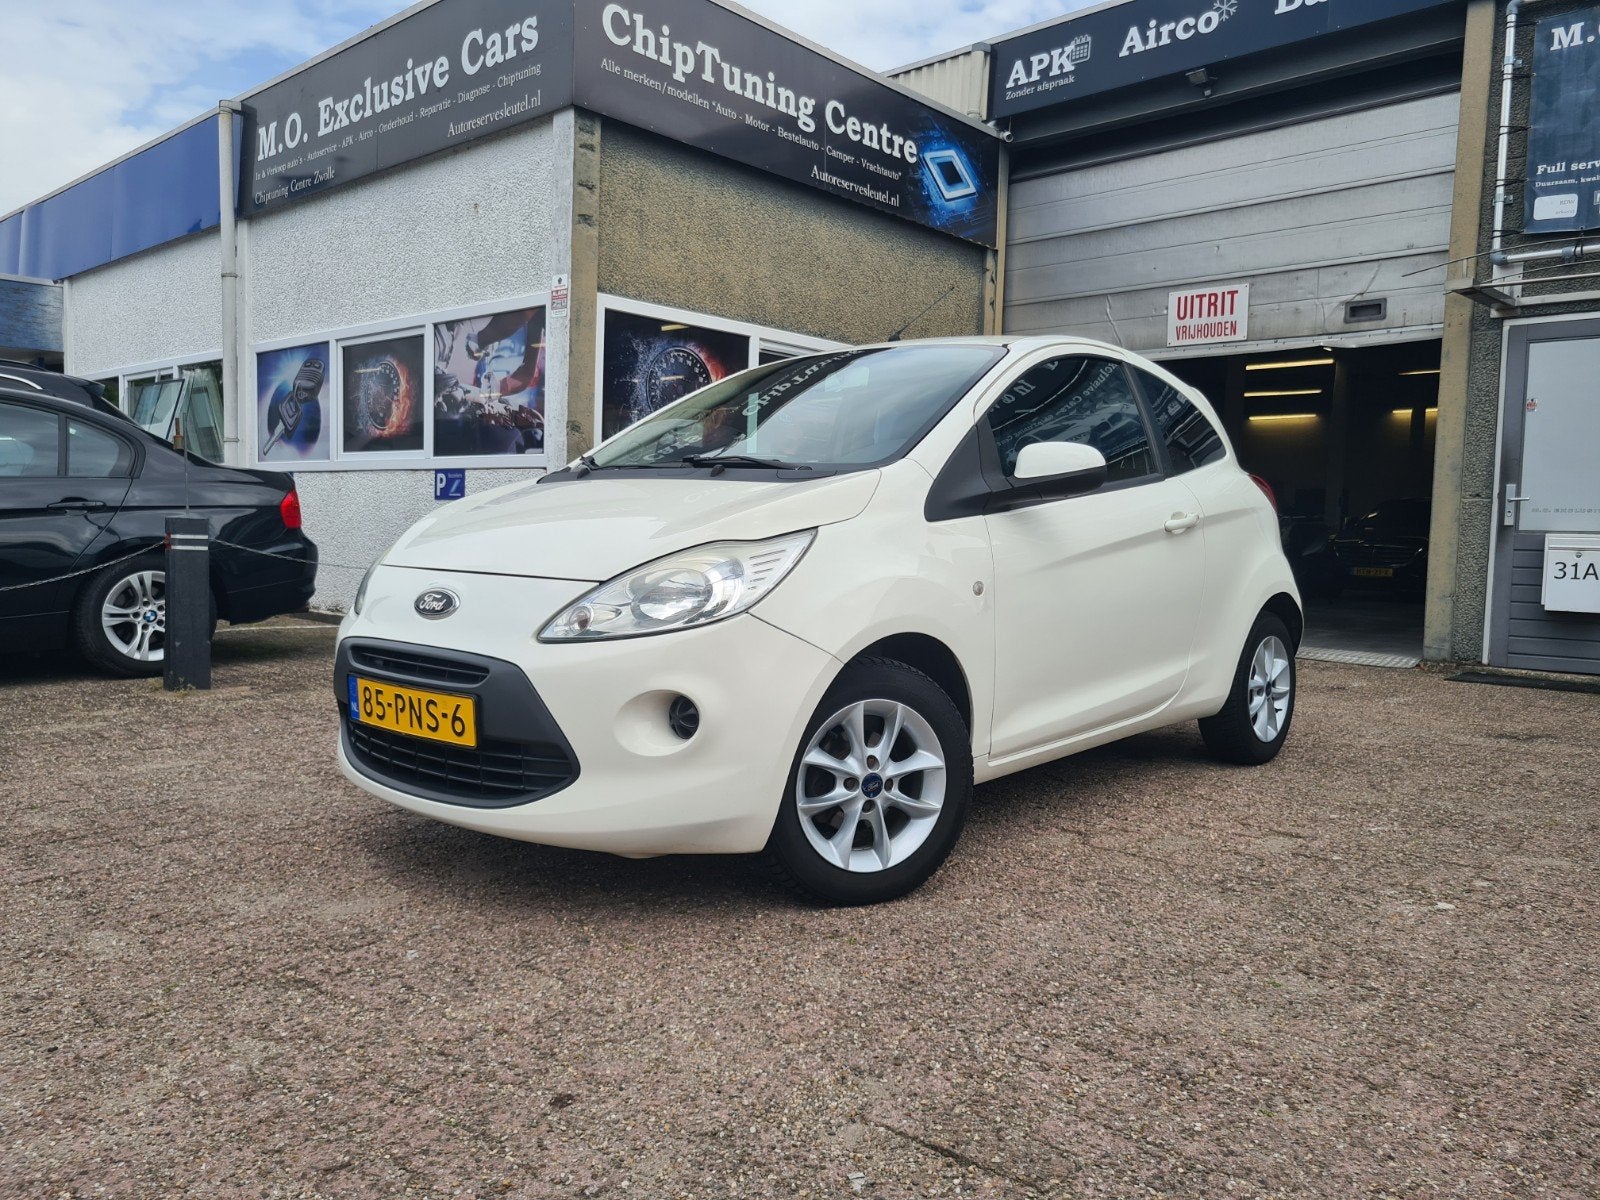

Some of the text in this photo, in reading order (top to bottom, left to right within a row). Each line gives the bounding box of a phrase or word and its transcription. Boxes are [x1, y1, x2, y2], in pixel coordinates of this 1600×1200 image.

[1119, 11, 1219, 58] Airco
[1550, 22, 1600, 51] M.
[602, 4, 918, 164] ChipTuning Centre
[1006, 44, 1075, 89] APK
[258, 16, 539, 161] M.O. Exclusive Cars
[1005, 75, 1075, 101] Zonder afspraak
[307, 144, 337, 161] Autoservice
[342, 135, 354, 148] APK
[358, 130, 374, 142] Airco
[378, 112, 414, 134] Onderhoud
[420, 97, 450, 118] Reparatie
[458, 84, 491, 104] Diagnose
[497, 64, 542, 88] Chiptuning
[448, 90, 541, 137] Autoreservesleutel.nl
[600, 58, 621, 75] Alle
[624, 69, 710, 110] merken/modellen
[745, 114, 769, 132] Motor
[778, 126, 819, 151] Bestelauto
[826, 146, 855, 165] Camper
[254, 166, 335, 205] Chiptuning Centre Zwolle
[811, 166, 899, 207] Autoreservesleutel.nl
[1536, 162, 1566, 175] Full
[1176, 290, 1239, 321] UITRIT
[1176, 320, 1237, 341] VRIJHOUDEN
[437, 473, 446, 496] P
[1554, 562, 1599, 581] 31A
[420, 593, 446, 612] Ford
[352, 702, 359, 712] NL
[363, 686, 466, 738] 85-PNS-6
